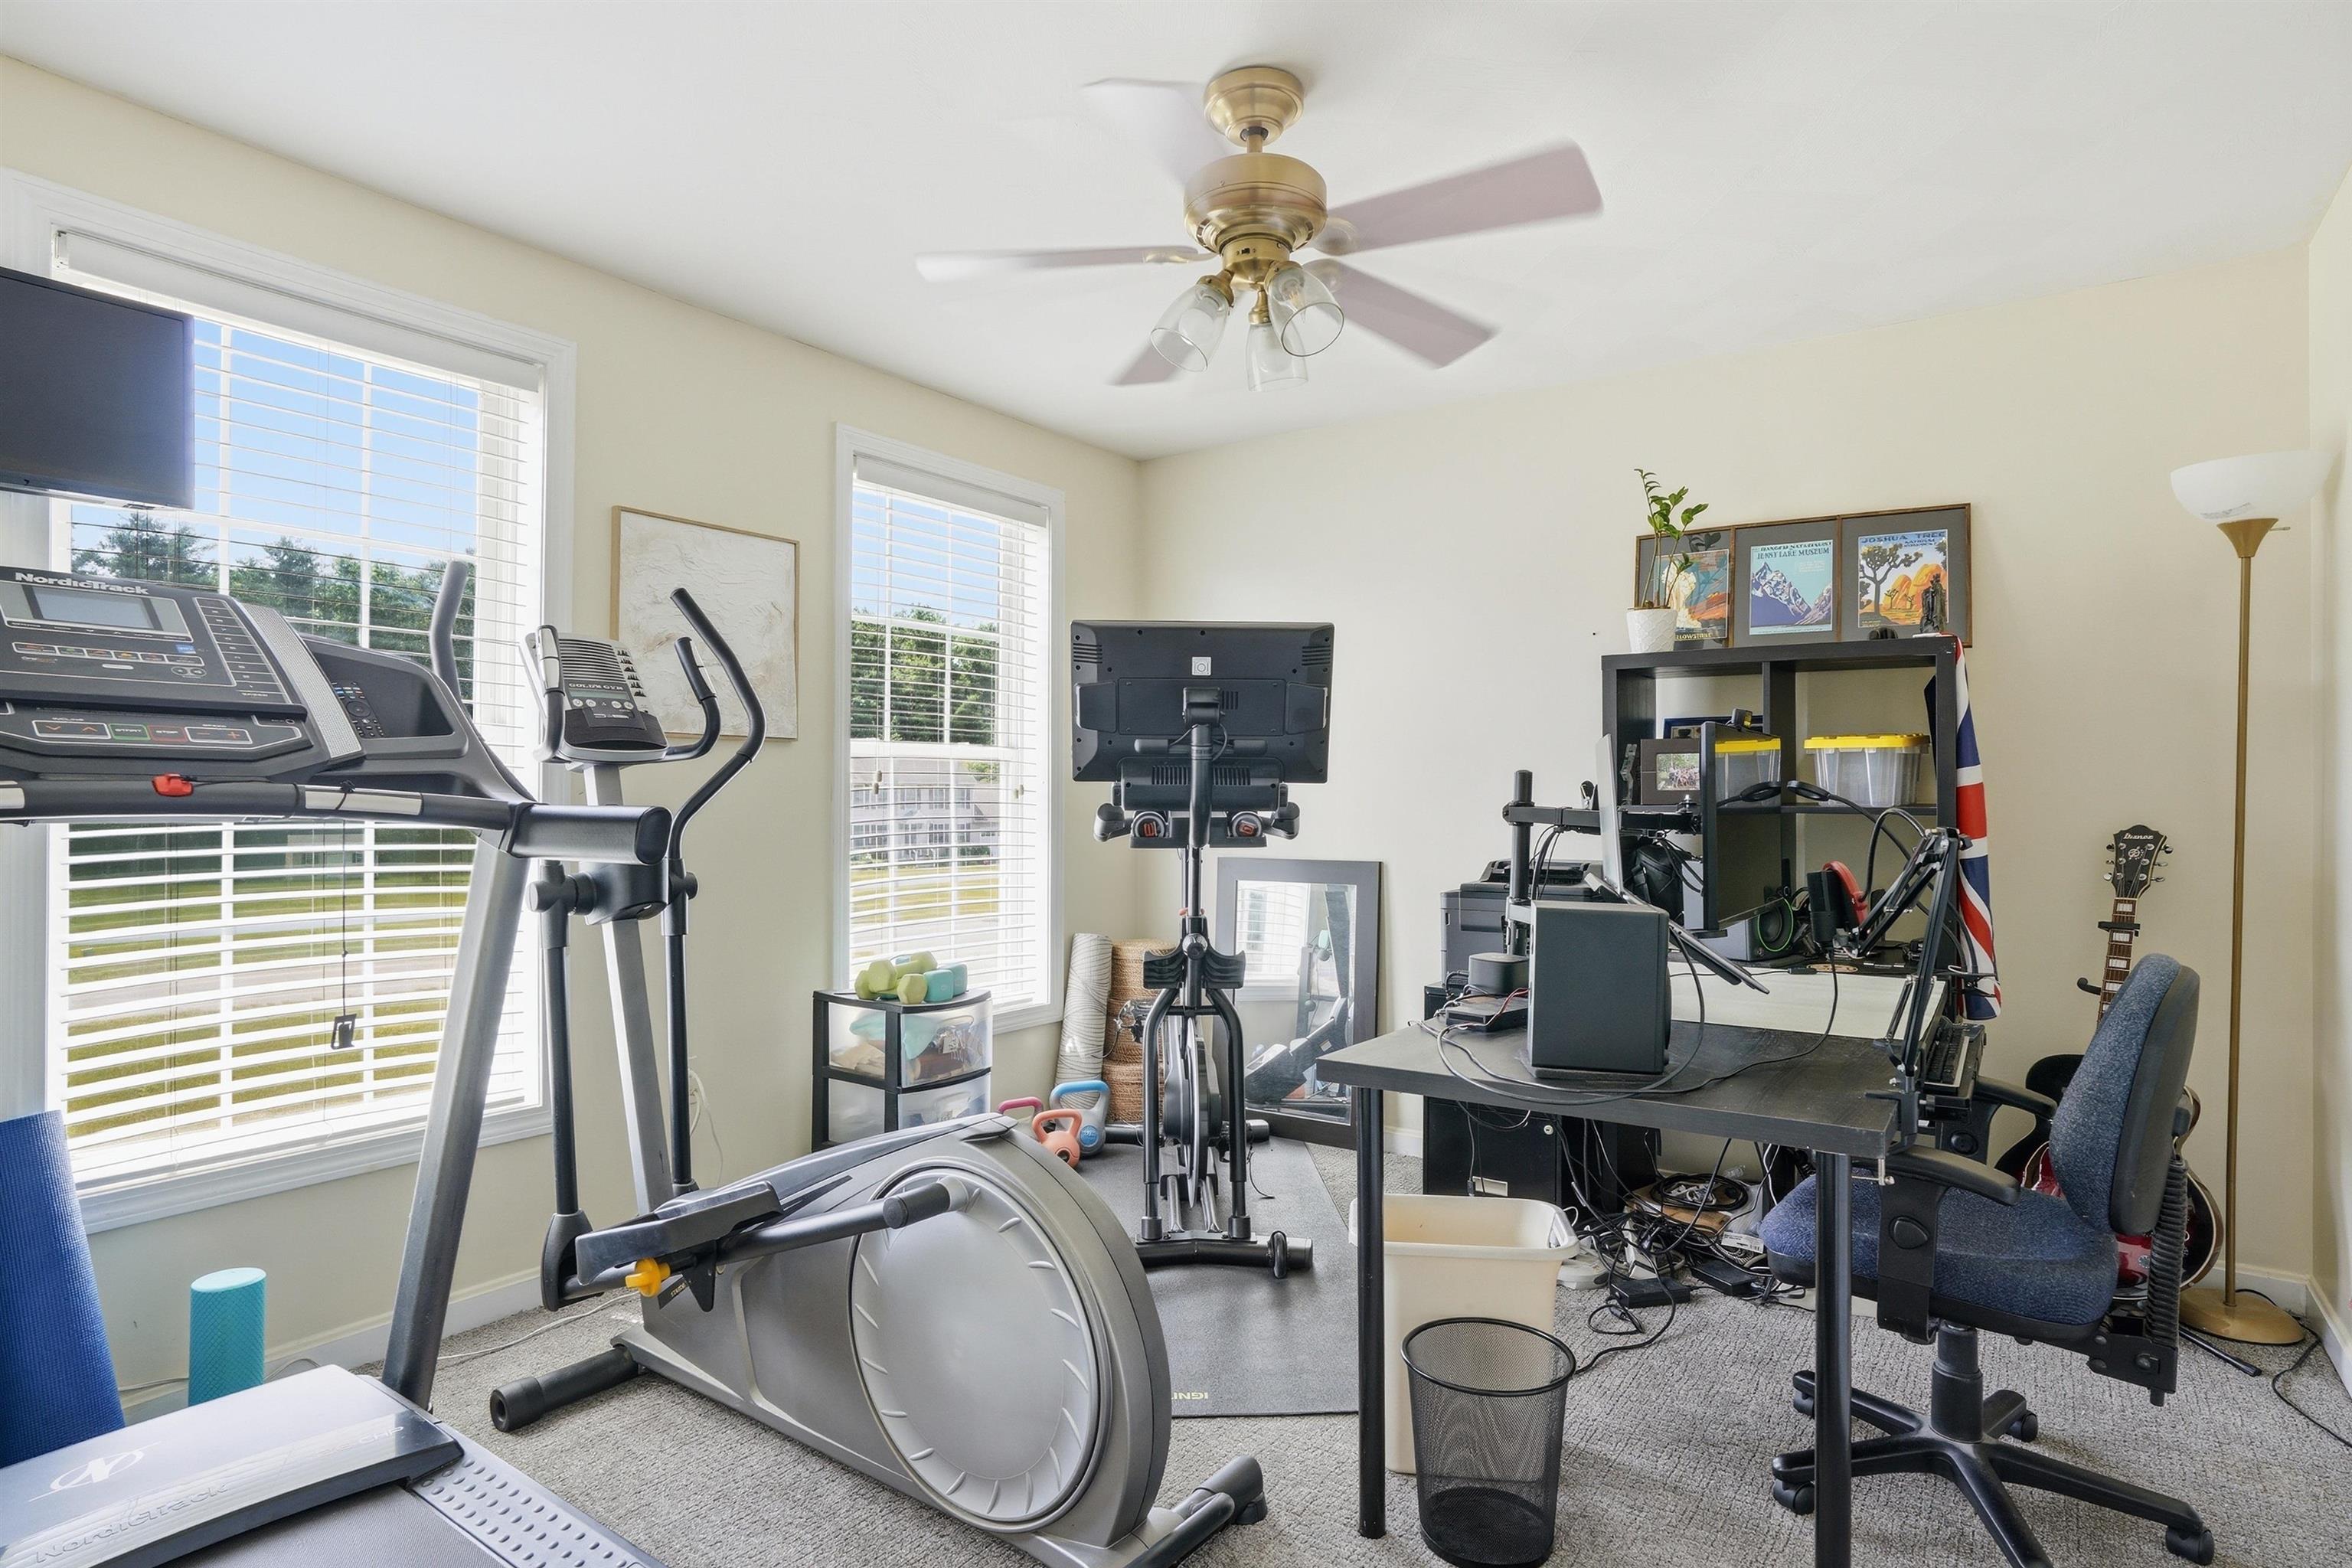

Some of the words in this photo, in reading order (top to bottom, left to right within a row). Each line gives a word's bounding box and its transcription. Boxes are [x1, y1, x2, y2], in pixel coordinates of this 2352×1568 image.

[1757, 551, 1777, 560] JENNY
[1799, 547, 1830, 556] MUSEUM
[15, 572, 149, 595] NordicTrack
